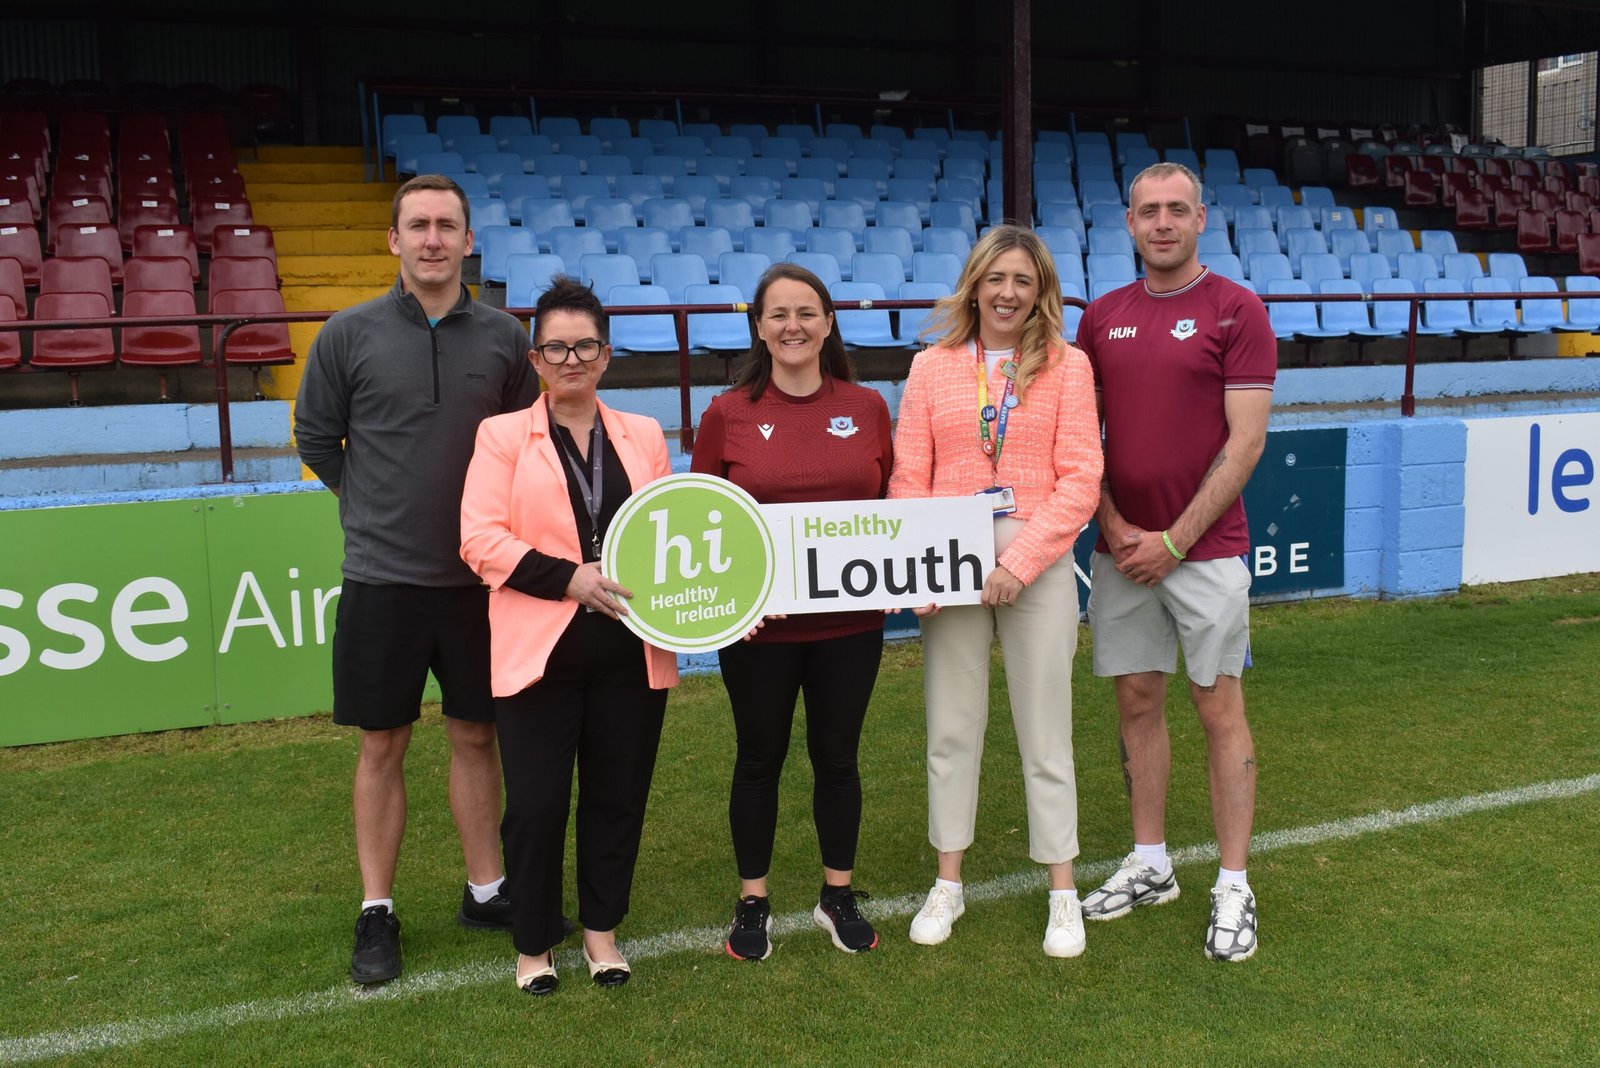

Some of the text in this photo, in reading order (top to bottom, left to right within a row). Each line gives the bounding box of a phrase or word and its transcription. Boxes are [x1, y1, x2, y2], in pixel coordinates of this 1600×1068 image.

[1108, 326, 1137, 340] HUH
[1527, 423, 1595, 516] le
[803, 513, 902, 540] Healthy
[648, 508, 733, 585] hi
[807, 538, 983, 600] Louth
[650, 585, 719, 612] Healthy
[675, 598, 737, 626] Ireland
